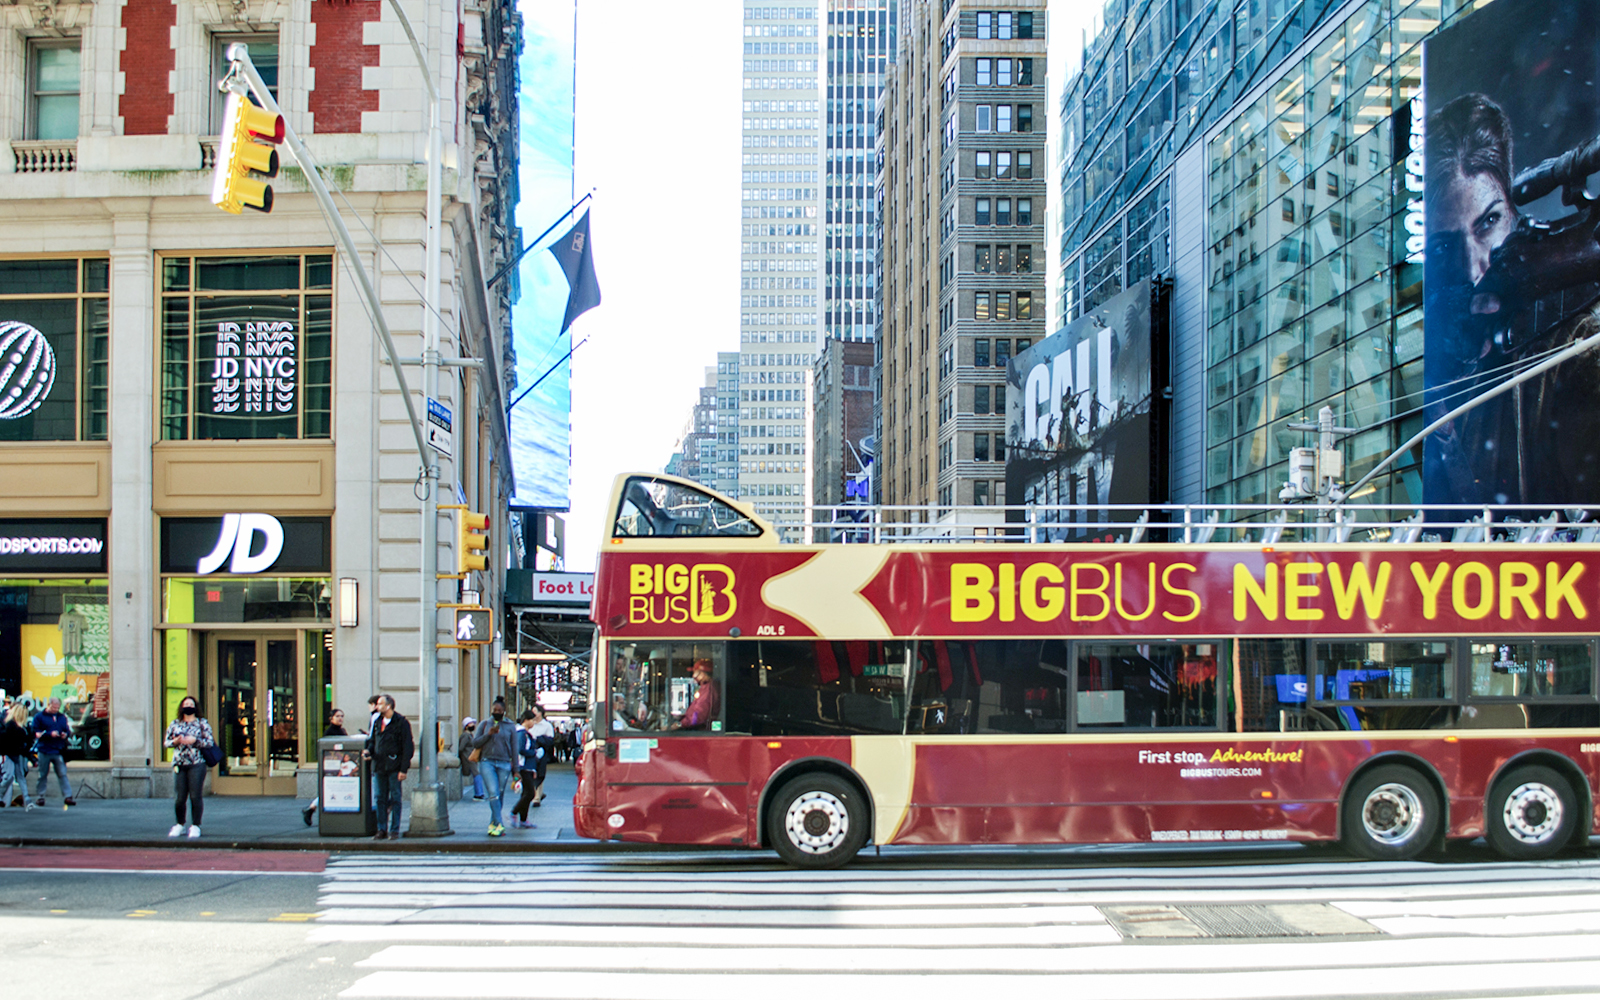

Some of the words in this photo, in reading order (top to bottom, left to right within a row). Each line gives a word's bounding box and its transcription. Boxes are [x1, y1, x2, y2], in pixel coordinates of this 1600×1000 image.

[211, 357, 240, 378] JD
[245, 356, 296, 378] NYC
[1024, 326, 1118, 446] CALL
[0, 537, 103, 554] DSPORTS.COM
[197, 513, 285, 575] JD
[539, 580, 574, 594] Foot
[630, 563, 689, 594] BIG
[1233, 561, 1391, 621] NEW
[1410, 561, 1586, 621] YORK
[630, 595, 689, 623] BUS
[757, 625, 777, 635] ADL
[778, 625, 785, 635] 5
[1138, 750, 1171, 764] First
[1173, 751, 1207, 766] stop.
[1209, 747, 1303, 763] Adventure!
[1180, 767, 1262, 778] BIGBUSTOURS.COM
